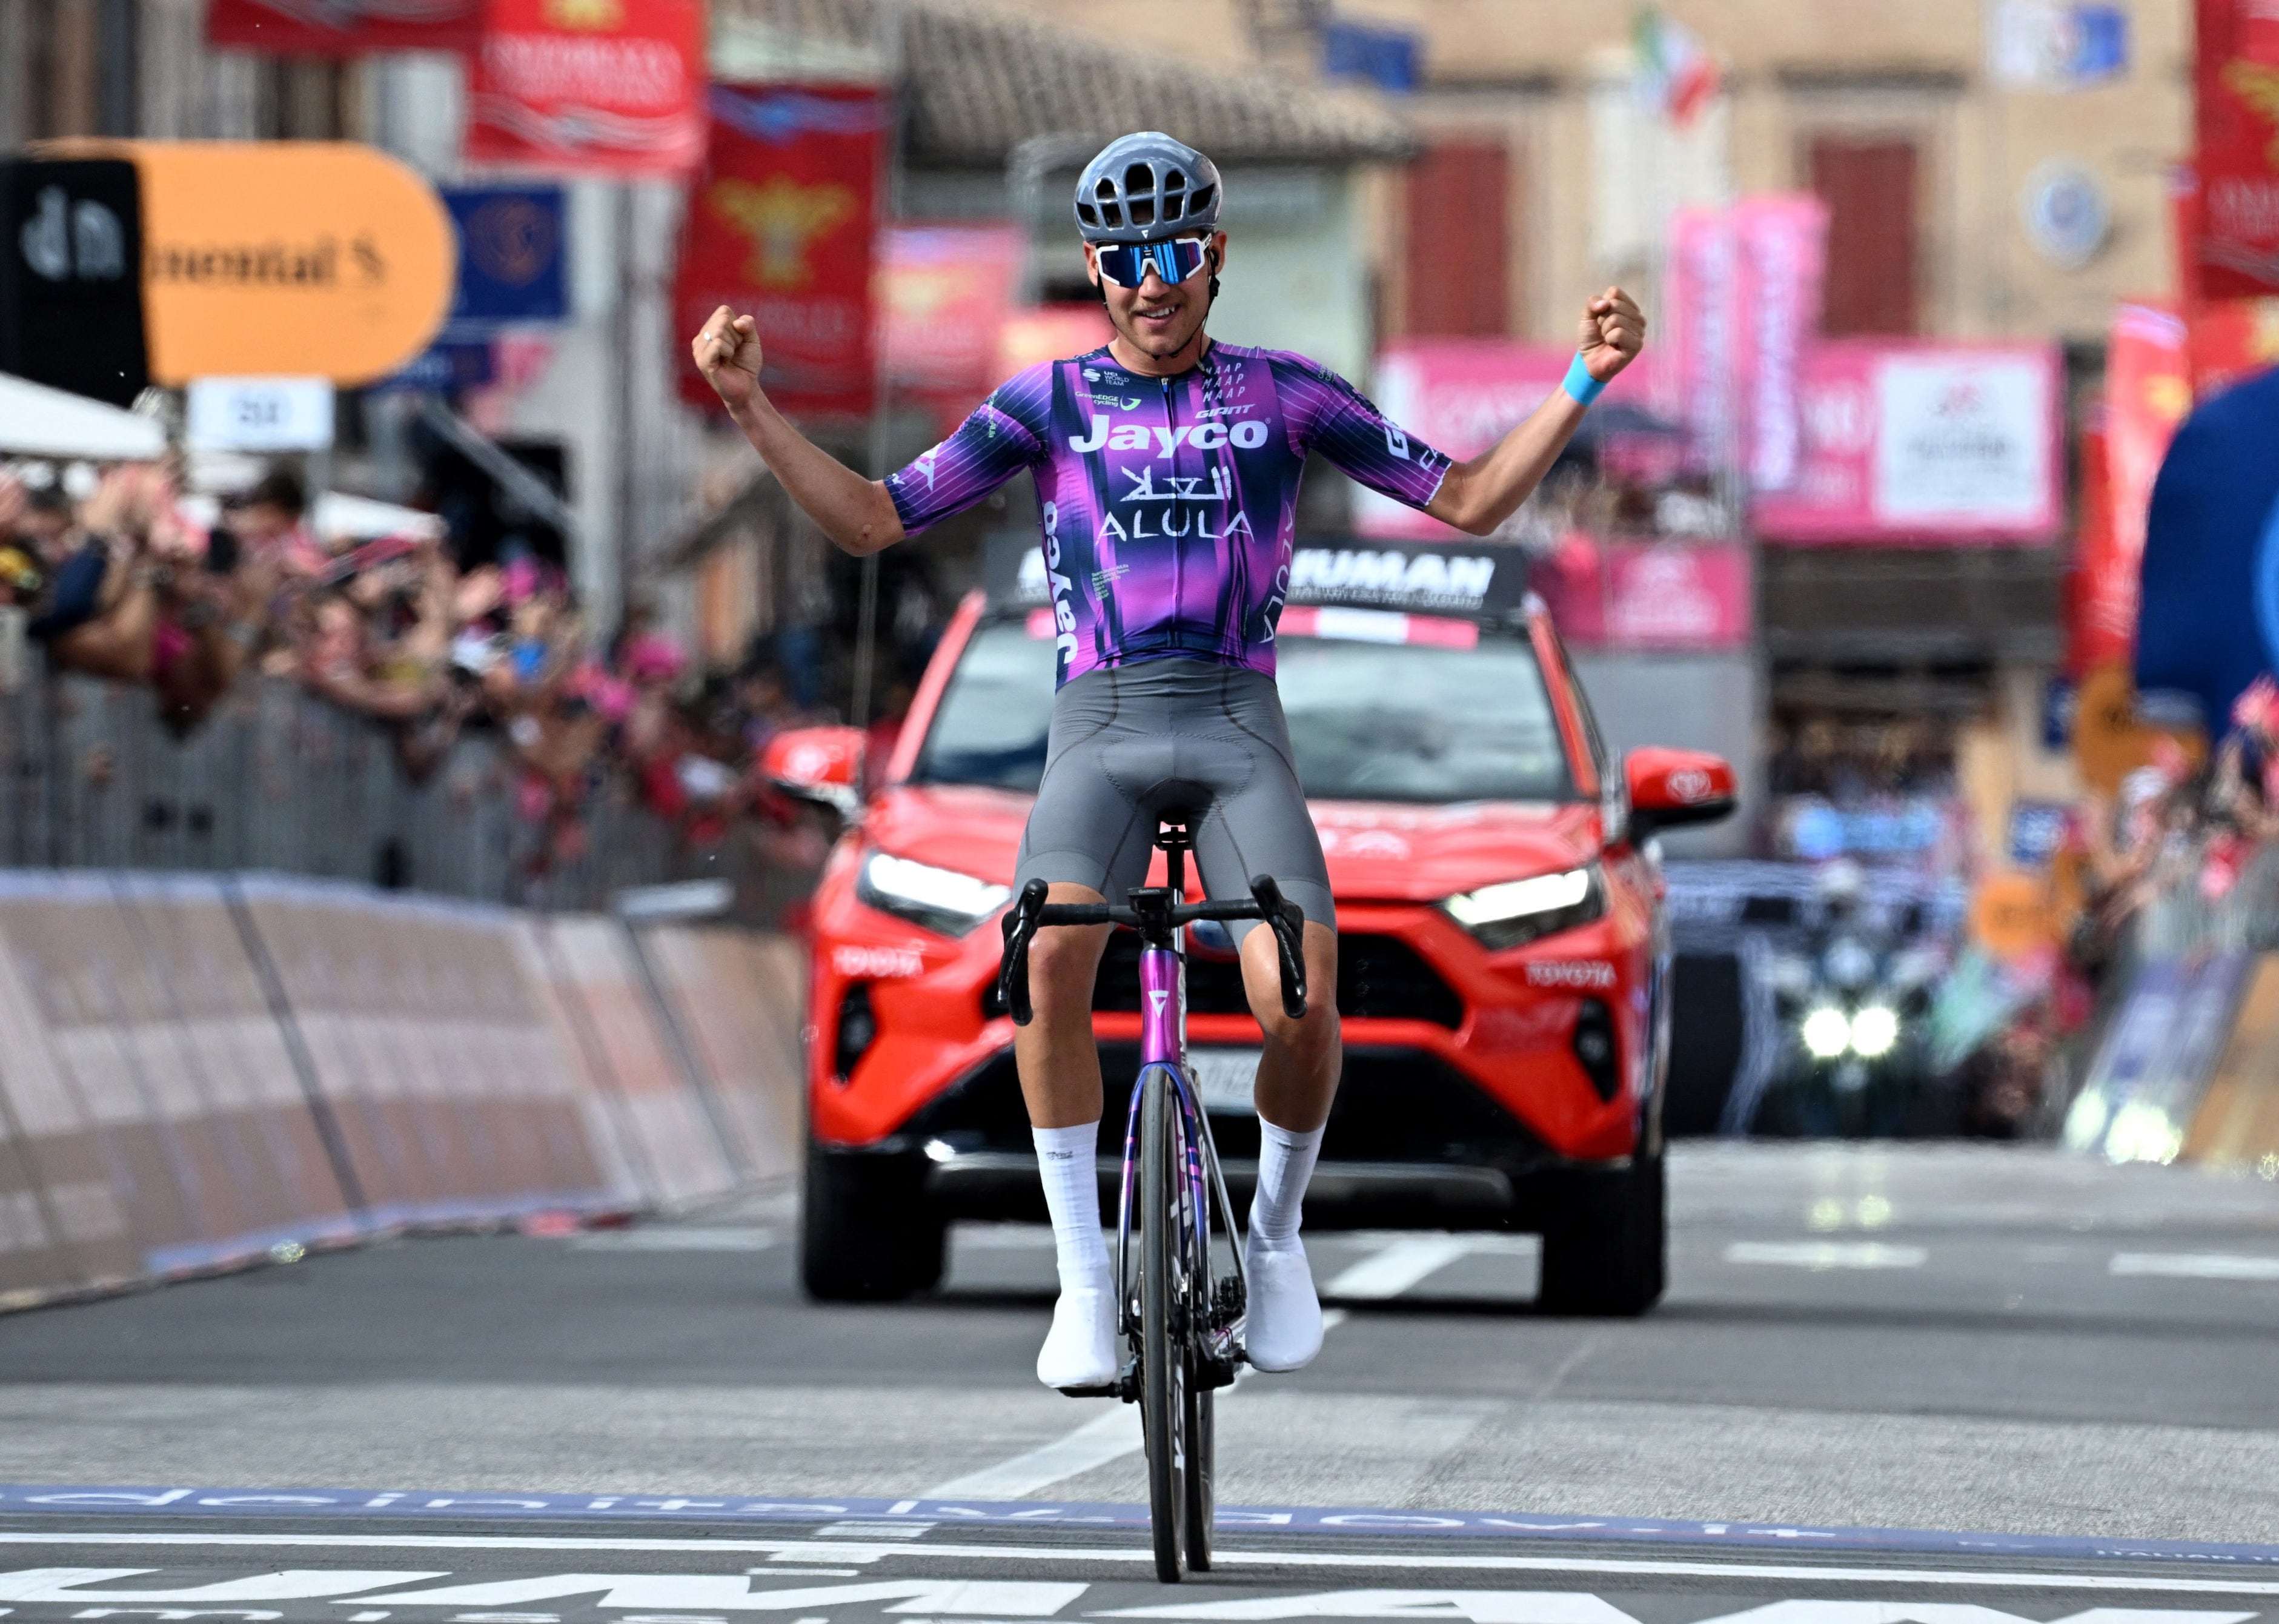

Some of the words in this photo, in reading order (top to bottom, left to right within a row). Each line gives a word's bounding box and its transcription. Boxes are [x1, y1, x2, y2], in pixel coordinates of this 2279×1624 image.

[1202, 373, 1244, 389] MAAP
[1075, 391, 1119, 402] GreenEDGE
[1203, 386, 1245, 402] MAAP
[1195, 404, 1255, 419] GIANT
[1069, 414, 1268, 459] Jayco
[1096, 507, 1255, 546] ALULA
[1044, 501, 1078, 664] Jayco
[1525, 959, 1617, 988] TOYOTA
